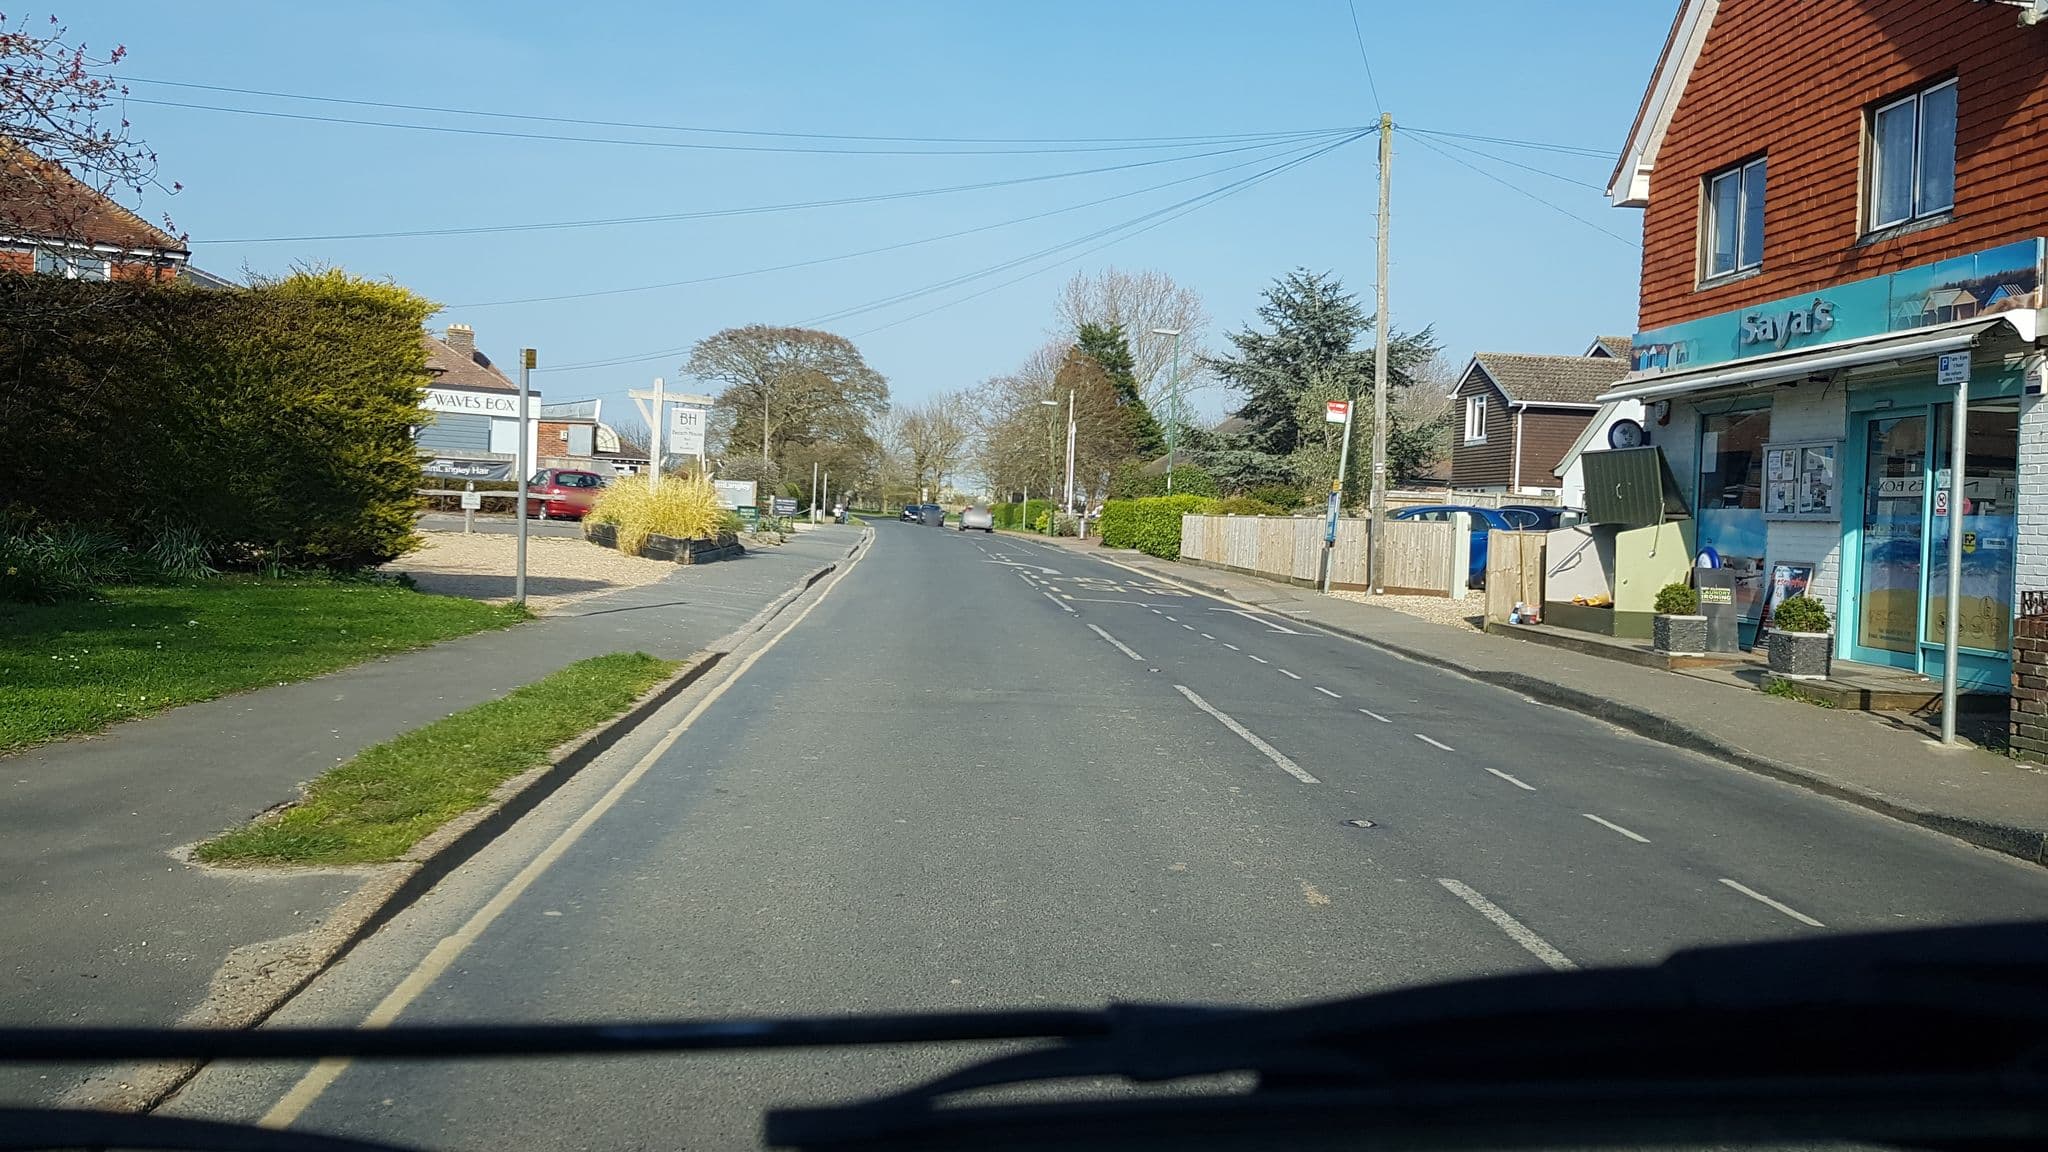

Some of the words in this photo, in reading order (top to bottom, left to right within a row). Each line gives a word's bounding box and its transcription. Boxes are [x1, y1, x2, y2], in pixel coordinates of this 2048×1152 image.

[1740, 298, 1835, 350] Saya's
[434, 393, 481, 409] WAVES
[485, 397, 516, 412] BOX
[680, 412, 697, 425] BH
